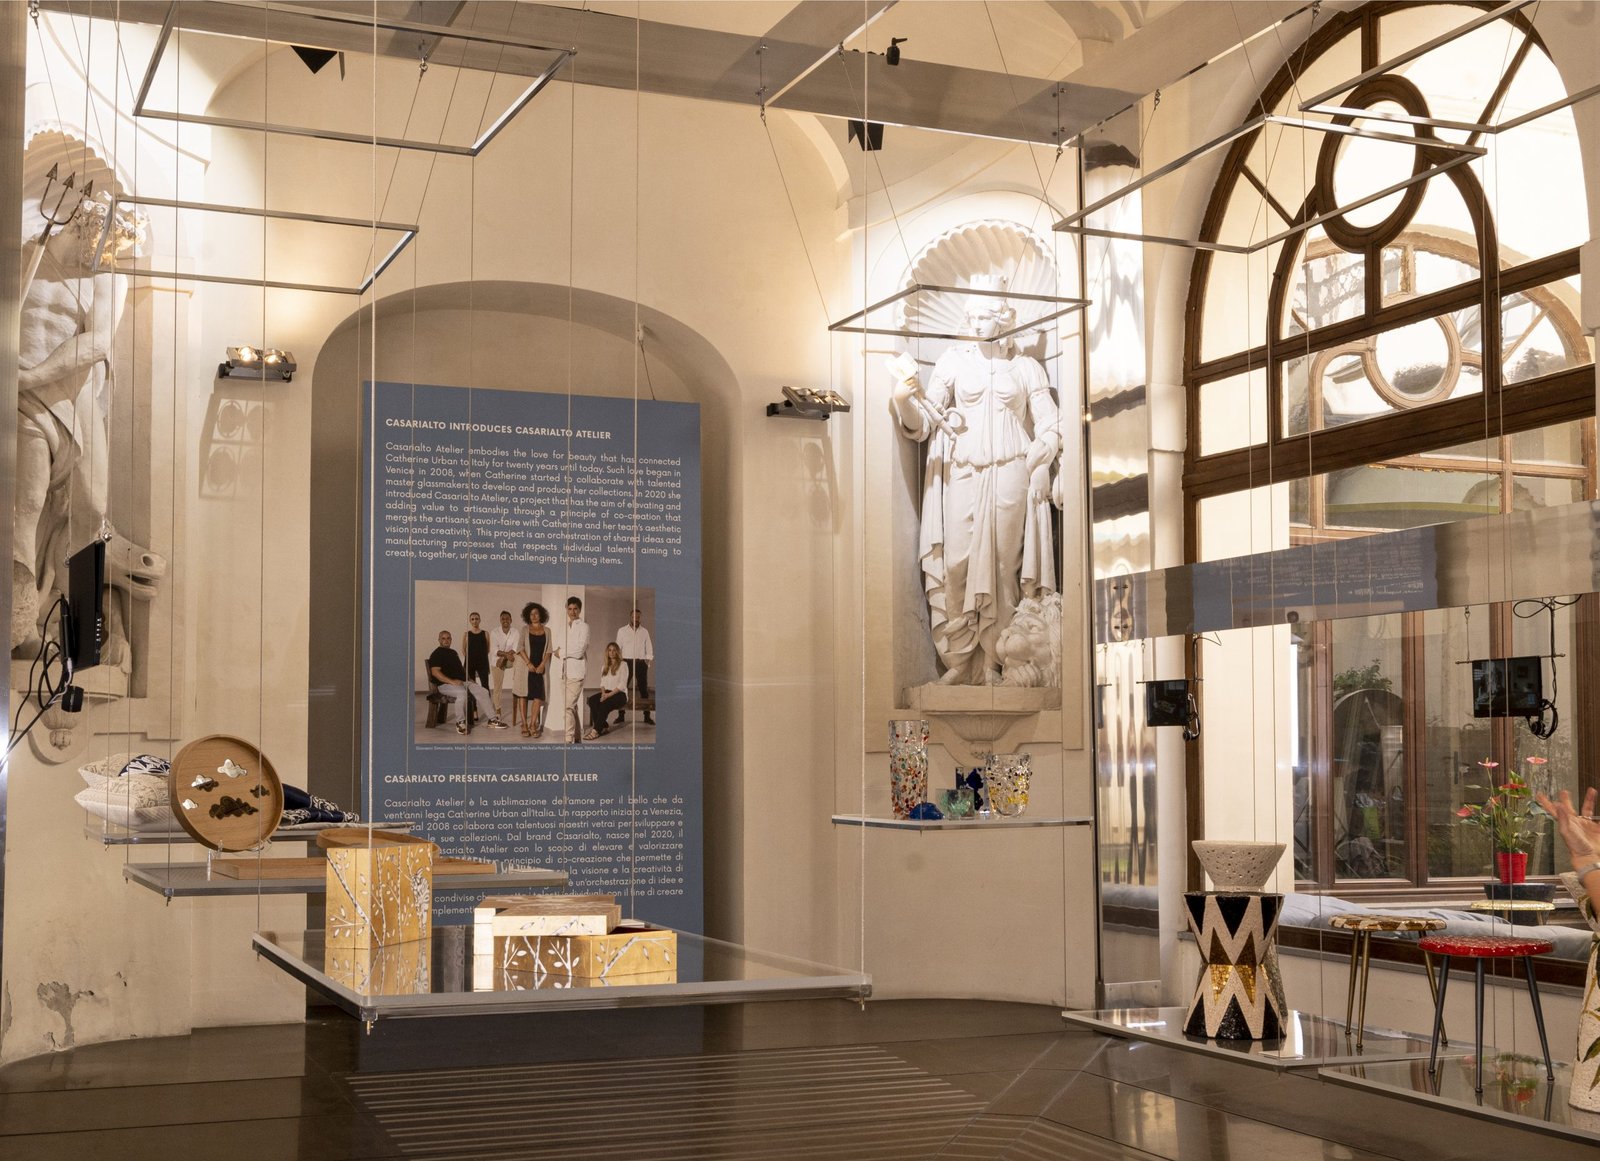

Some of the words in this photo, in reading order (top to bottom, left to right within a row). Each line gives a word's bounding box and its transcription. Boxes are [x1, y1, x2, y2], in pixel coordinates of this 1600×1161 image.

[386, 418, 446, 430] CASARIALTO
[450, 422, 512, 433] INTRODUCES
[516, 426, 573, 437] CASARIALTO
[576, 430, 611, 439] ATELIER
[436, 444, 464, 454] Atelier
[469, 446, 509, 456] embodies
[514, 448, 527, 457] the
[532, 449, 548, 458] love
[553, 450, 564, 459] for
[569, 451, 596, 463] beauty
[601, 453, 617, 462] that
[622, 454, 634, 463] has
[639, 455, 681, 465] connected
[386, 453, 429, 464] Catherine
[432, 455, 458, 465] Urban
[460, 458, 469, 466] to
[472, 457, 490, 469] Italy
[492, 458, 504, 468] for
[506, 461, 534, 471] twenty
[536, 464, 558, 472] years
[580, 463, 605, 475] today.
[607, 465, 625, 474] Such
[646, 467, 672, 478] began
[386, 465, 415, 475] Venice
[431, 468, 456, 478] 2008,
[485, 470, 527, 480] Catherine
[531, 472, 560, 482] started
[577, 474, 624, 485] collaborate
[648, 478, 681, 488] talented
[386, 478, 415, 486] master
[418, 478, 468, 491] glassmakers
[471, 482, 480, 490] to
[482, 481, 516, 493] develop
[519, 483, 535, 492] and
[537, 484, 571, 496] produce
[574, 486, 587, 495] her
[645, 490, 666, 498] 2020
[668, 490, 681, 499] she
[386, 488, 432, 499] introduced
[482, 493, 511, 503] Atelier,
[520, 496, 550, 506] project
[552, 496, 568, 505] that
[570, 497, 584, 506] has
[586, 498, 599, 507] the
[617, 499, 625, 508] of
[666, 502, 681, 510] and
[386, 500, 417, 512] adding
[422, 502, 445, 511] value
[464, 504, 509, 516] artisanship
[514, 506, 545, 518] through
[601, 510, 609, 518] of
[666, 513, 681, 522] that
[386, 515, 417, 524] merges
[420, 513, 433, 522] the
[472, 516, 521, 526] savoir-faire
[523, 518, 540, 527] with
[542, 519, 583, 529] Catherine
[585, 520, 601, 529] and
[603, 521, 616, 530] her
[645, 523, 681, 533] aesthetic
[385, 525, 409, 533] vision
[412, 525, 428, 534] and
[477, 528, 492, 536] This
[494, 529, 524, 540] project
[547, 530, 601, 541] orchestration
[603, 533, 611, 541] of
[614, 533, 640, 542] shared
[643, 534, 664, 543] ideas
[666, 535, 681, 544] and
[453, 541, 495, 550] processes
[500, 540, 517, 549] that
[523, 542, 558, 553] respects
[641, 547, 668, 557] aiming
[386, 549, 417, 558] create,
[419, 549, 458, 561] together,
[490, 551, 507, 560] and
[509, 552, 557, 564] challenging
[600, 556, 623, 564] items.
[384, 775, 446, 783] CASARIALTO
[449, 774, 498, 782] PRESENTA
[501, 774, 560, 782] CASARIALTO
[436, 797, 464, 806] Atelier
[480, 797, 488, 806] la
[493, 797, 547, 806] sublimazione
[653, 795, 667, 804] che
[672, 795, 683, 804] da
[426, 810, 445, 821] lega
[493, 809, 519, 817] Urban
[559, 808, 570, 816] Un
[572, 809, 609, 818] rapporto
[650, 807, 684, 816] Venezia,
[427, 822, 450, 830] 2008
[516, 820, 556, 829] talentuosi
[592, 820, 615, 828] vetrai
[635, 818, 675, 829] sviluppare
[460, 832, 503, 842] collezioni.
[507, 832, 521, 841] Dal
[527, 832, 552, 840] brand
[635, 830, 646, 838] nel
[652, 830, 675, 839] 2020,
[480, 844, 508, 853] Atelier
[535, 843, 543, 852] lo
[579, 842, 587, 851] di
[592, 842, 623, 851] elevare
[639, 841, 683, 850] valorizzare
[545, 855, 553, 863] di
[617, 853, 631, 862] che
[635, 854, 671, 863] permette
[570, 866, 578, 874] la
[582, 866, 609, 874] visione
[622, 864, 630, 873] la
[659, 875, 676, 884] idee
[647, 887, 654, 895] di
